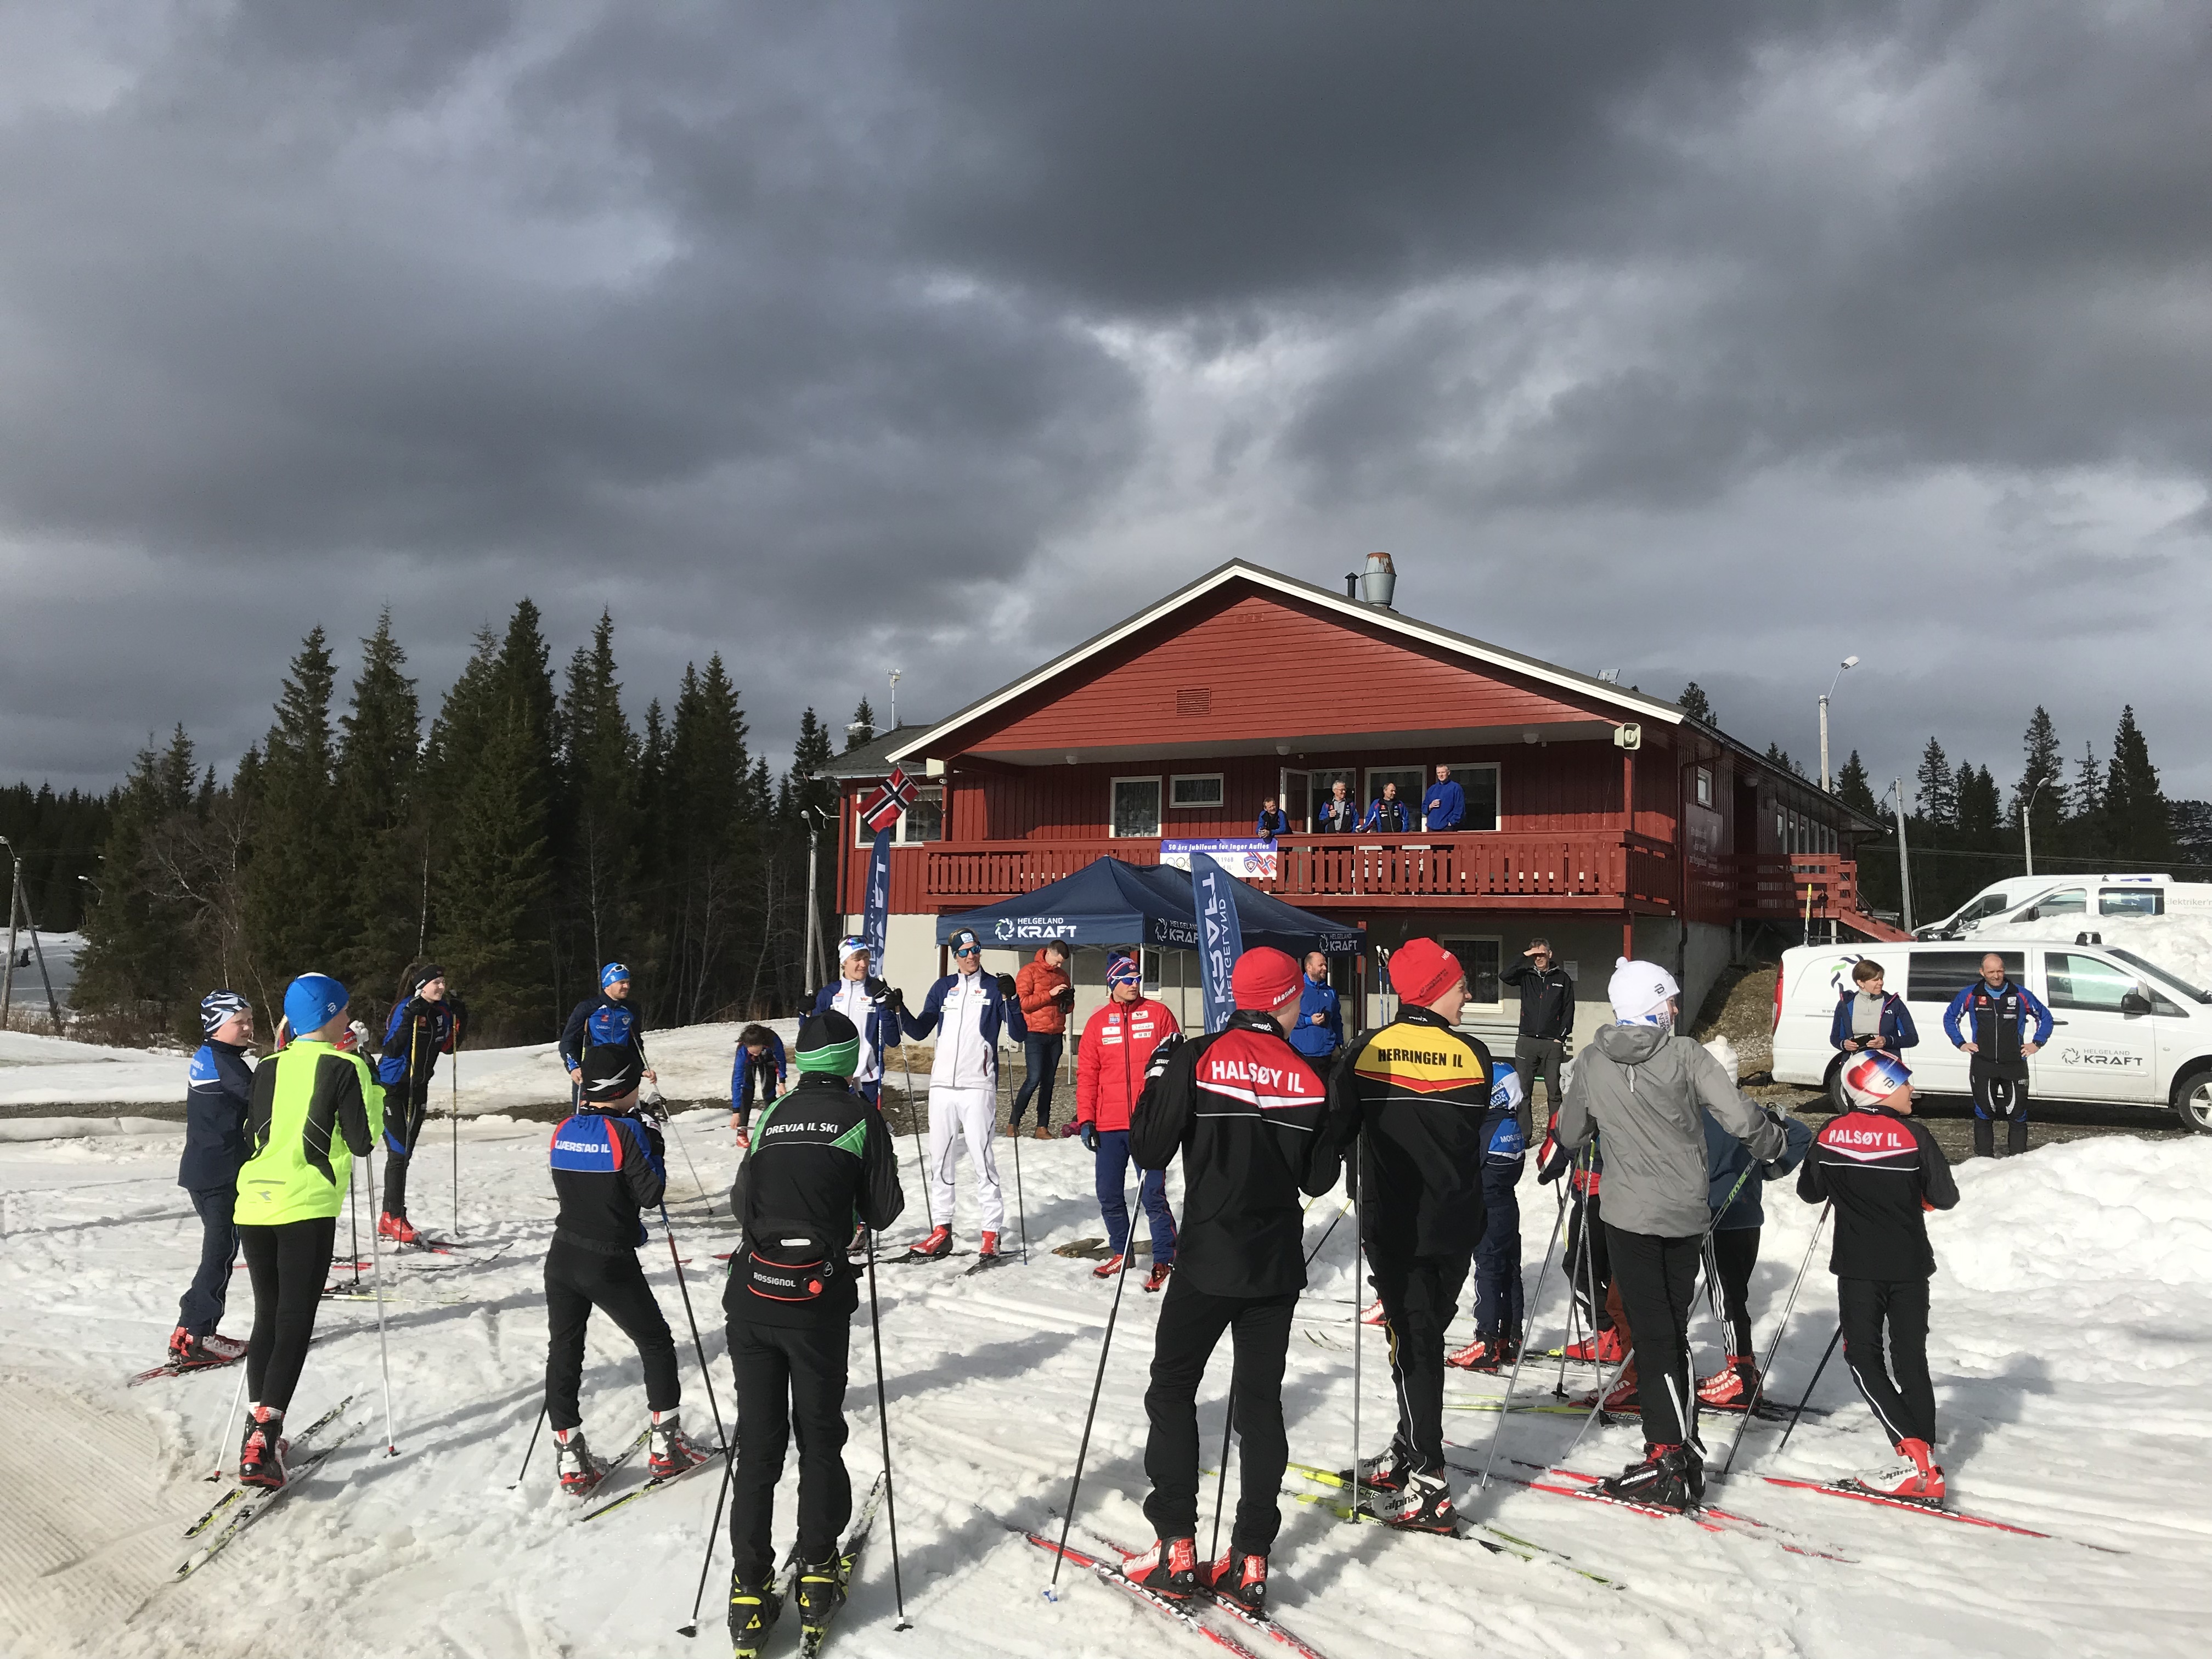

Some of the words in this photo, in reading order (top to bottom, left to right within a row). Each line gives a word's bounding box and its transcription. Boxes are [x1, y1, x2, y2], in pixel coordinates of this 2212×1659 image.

[1189, 843, 1217, 852] jubileum
[1229, 843, 1248, 851] Inger
[1017, 926, 1077, 938] KRAFT
[1169, 929, 1198, 944] KRAF
[1330, 940, 1357, 951] KRAFT
[1378, 1048, 1447, 1066] HERRINGEN
[1453, 1054, 1463, 1068] IL
[2084, 1055, 2143, 1066] KRAFT
[1211, 1060, 1283, 1088] HALSØY
[1287, 1072, 1305, 1093] IL
[765, 1123, 804, 1136] DREVJA
[806, 1122, 817, 1131] IL
[819, 1122, 838, 1134] SKI
[1829, 1129, 1883, 1147] HALSØY
[1887, 1133, 1901, 1147] IL
[601, 1143, 611, 1153] IL
[753, 1272, 797, 1287] ROSSIGNOL
[1364, 1454, 1395, 1468] alpina
[1620, 1469, 1658, 1486] MADSHUS
[1384, 1493, 1419, 1511] alpina
[1573, 1491, 1671, 1518] MADSH
